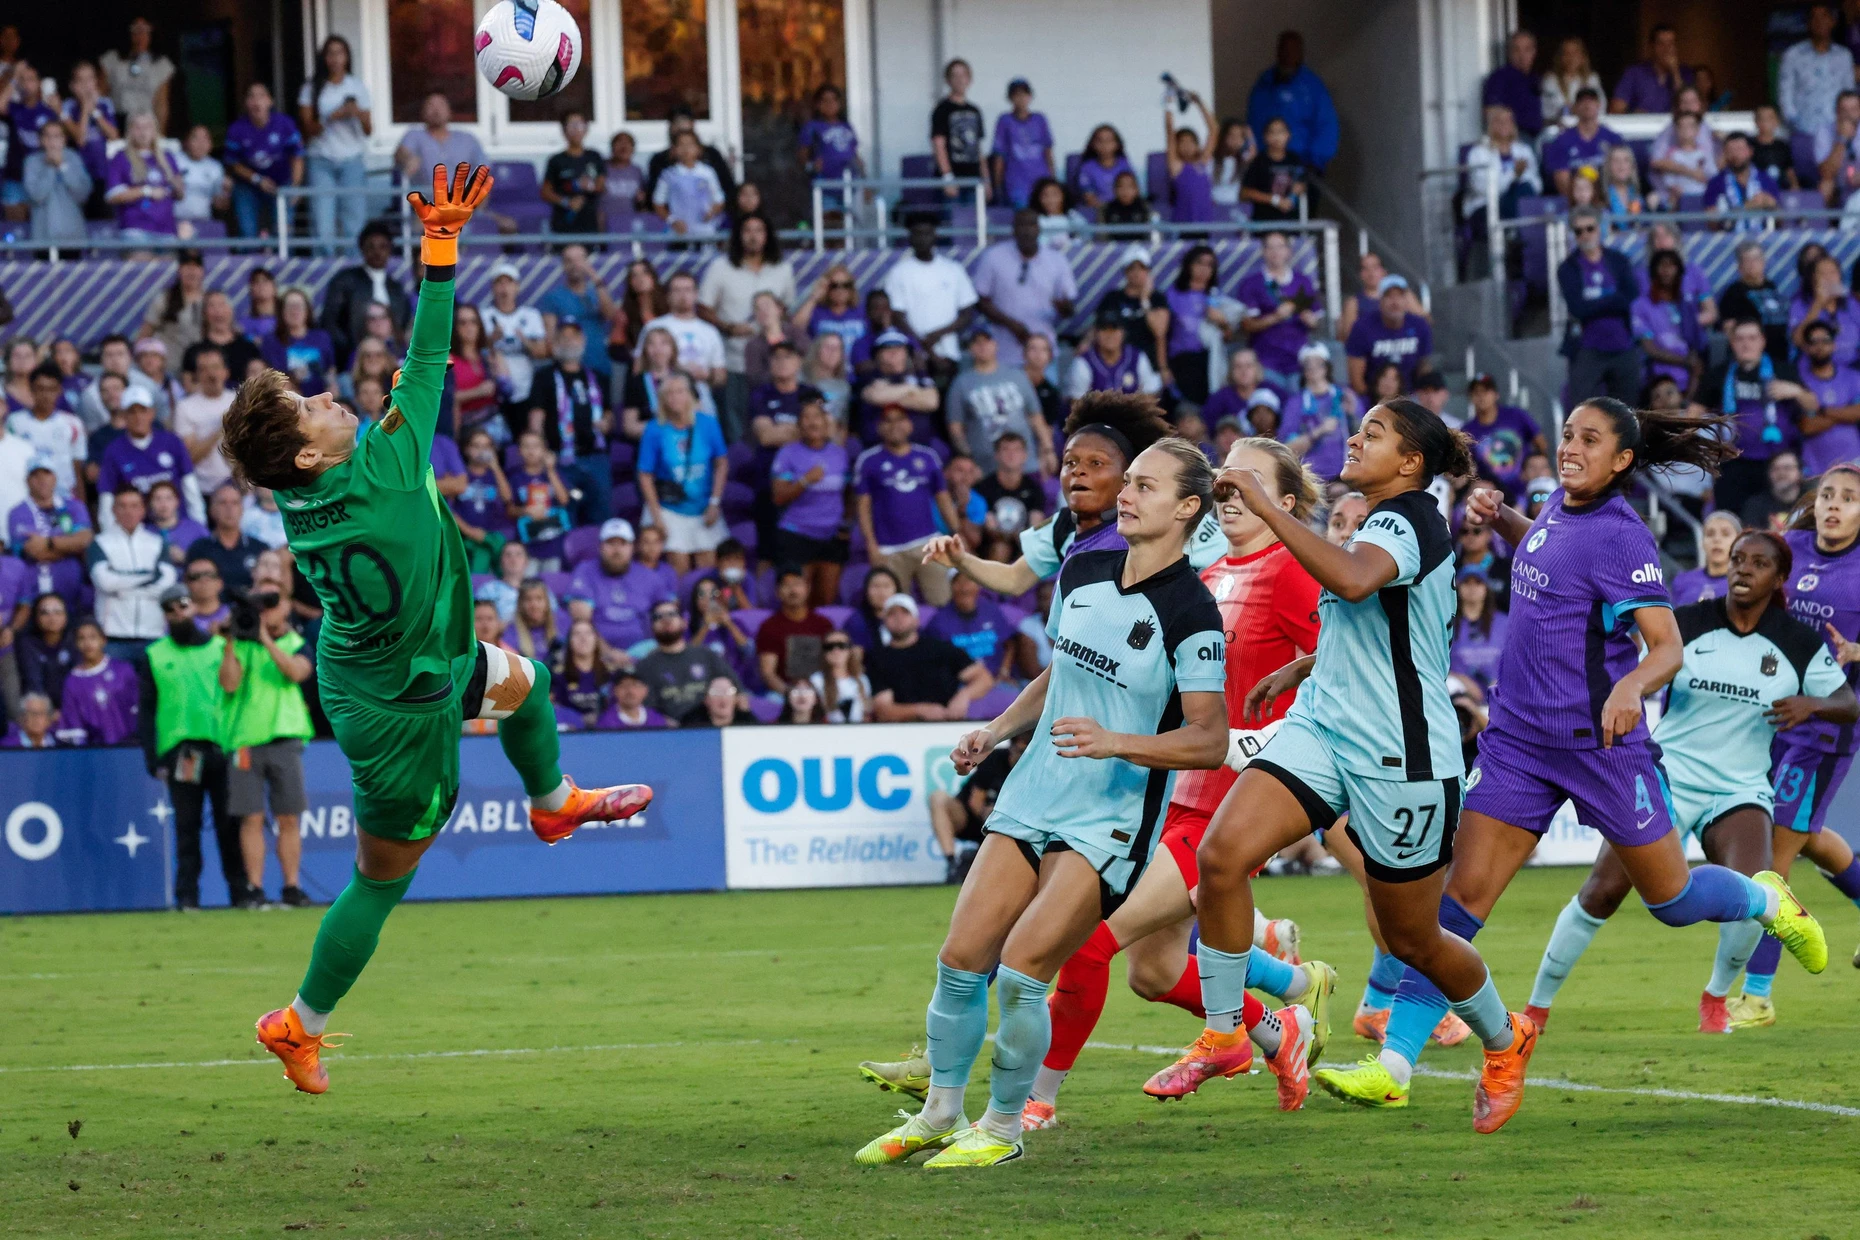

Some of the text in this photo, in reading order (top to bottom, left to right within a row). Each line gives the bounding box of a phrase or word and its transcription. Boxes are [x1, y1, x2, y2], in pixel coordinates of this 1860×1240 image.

[288, 501, 352, 536] BERGER
[308, 542, 403, 621] 30
[1511, 556, 1549, 587] LANDO
[1631, 563, 1663, 585] ally
[1197, 641, 1225, 664] all
[742, 754, 912, 814] OUC
[1634, 774, 1655, 815] 4
[1774, 763, 1804, 803] 13
[1391, 803, 1438, 848] 27
[744, 838, 799, 866] The
[807, 834, 919, 864] Reliable
